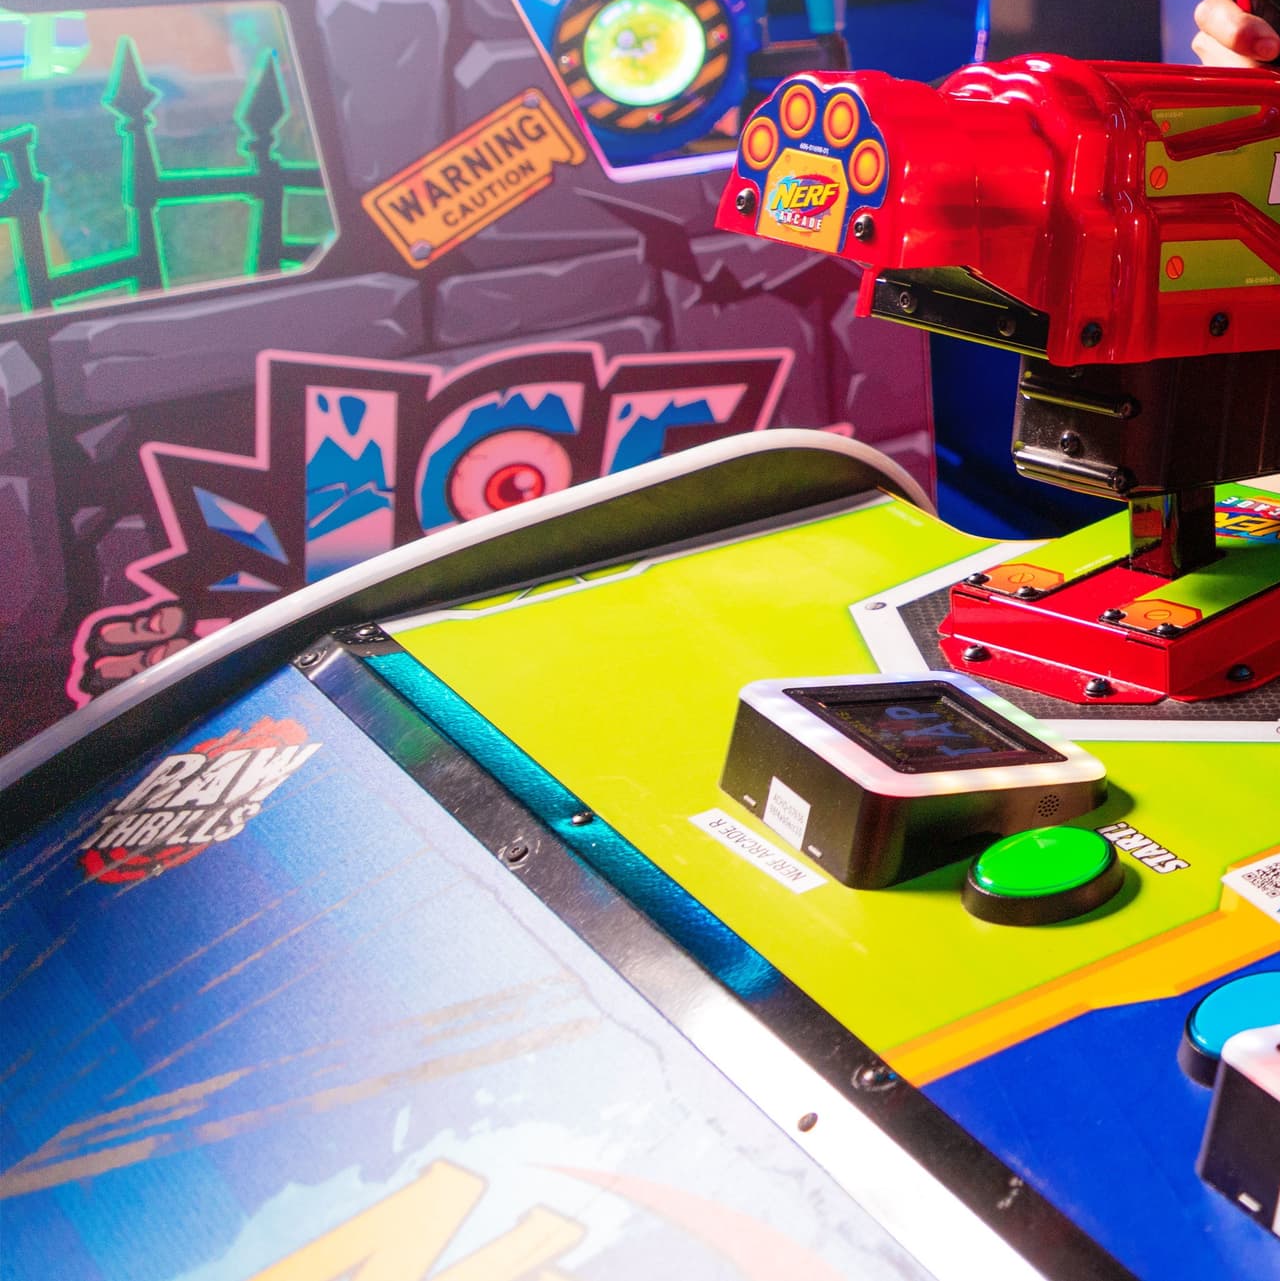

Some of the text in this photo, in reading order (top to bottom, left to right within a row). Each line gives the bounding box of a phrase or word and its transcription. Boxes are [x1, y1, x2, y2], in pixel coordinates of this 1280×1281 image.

[388, 115, 547, 224] WARNING
[441, 160, 537, 227] CAUTION
[771, 181, 840, 211] NERF
[779, 210, 823, 231] ARCADE
[113, 742, 323, 811] RAW
[78, 802, 262, 851] THRILLS
[719, 825, 776, 859] ARCADE
[1097, 821, 1191, 875] START!
[767, 859, 807, 882] NERF
